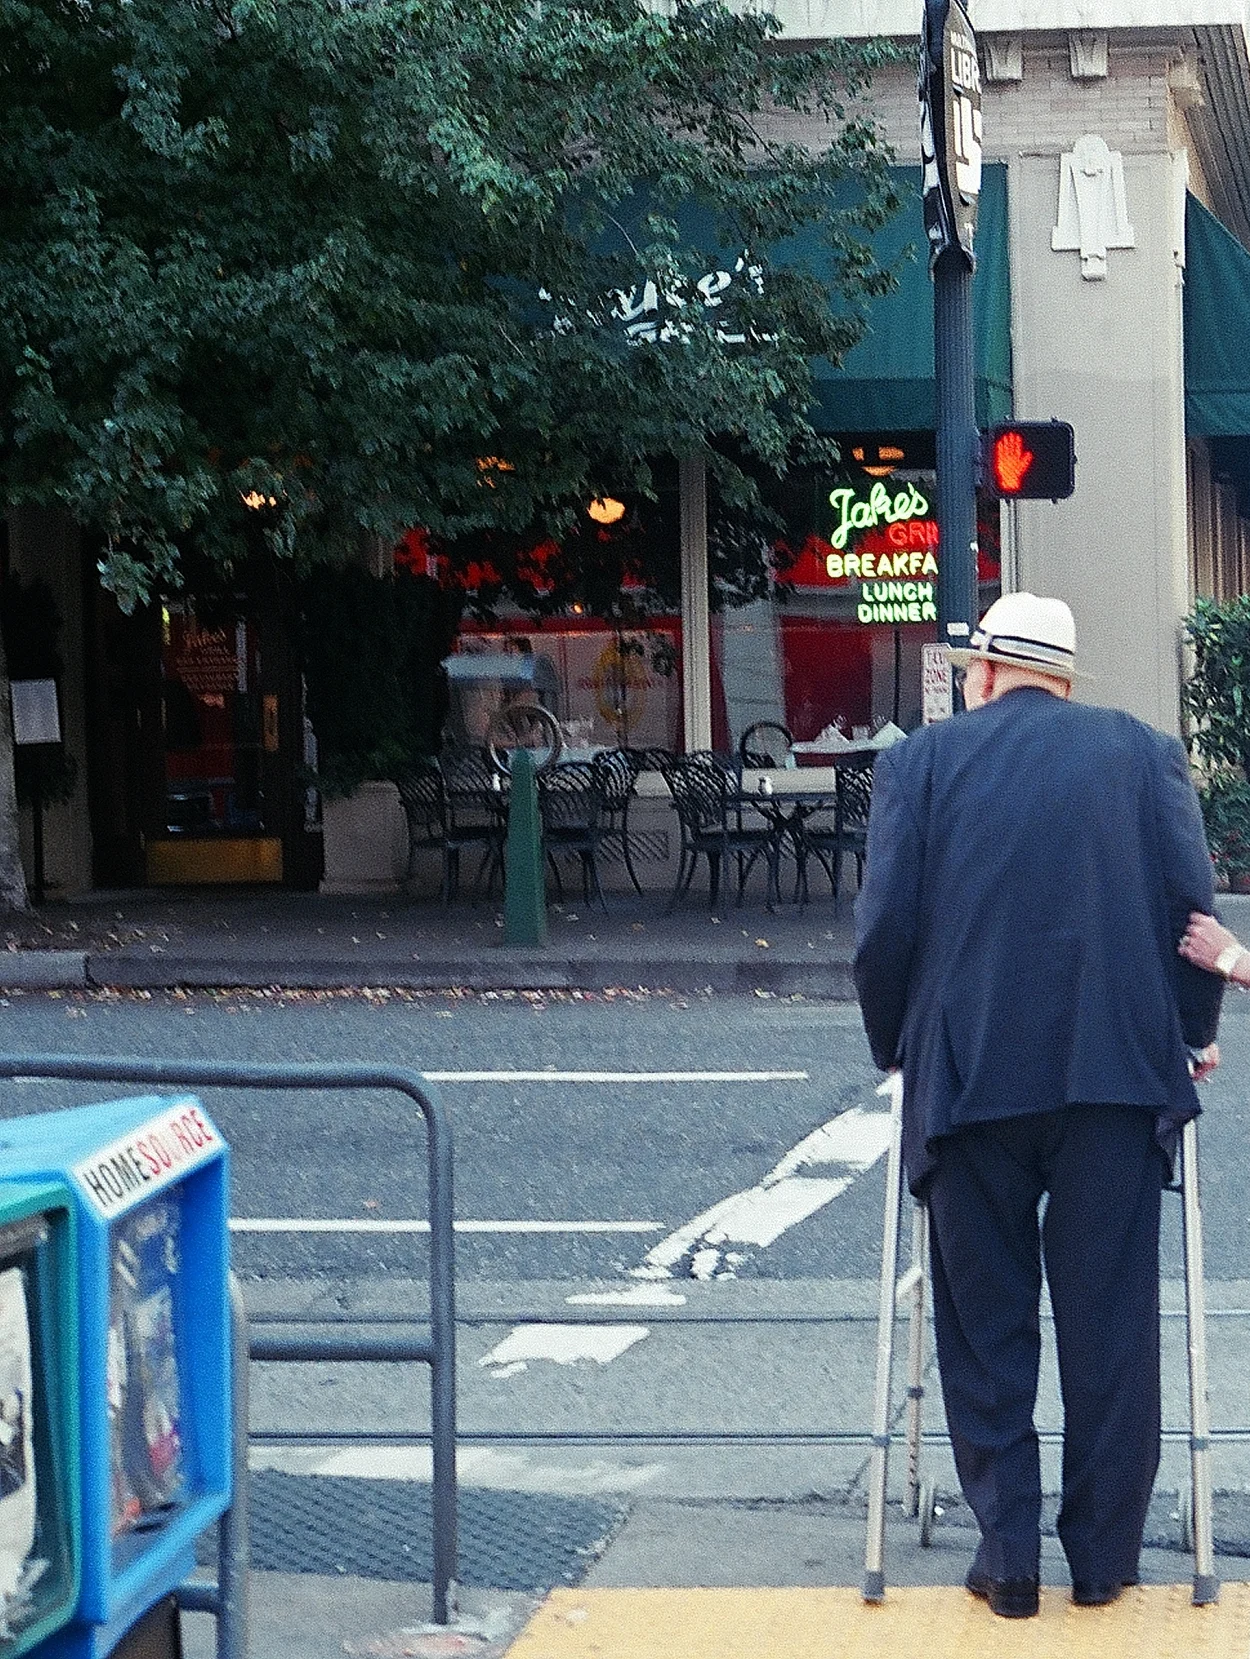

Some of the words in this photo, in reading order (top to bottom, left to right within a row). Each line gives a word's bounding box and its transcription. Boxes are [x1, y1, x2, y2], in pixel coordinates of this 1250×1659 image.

[829, 481, 929, 549] Jake's
[888, 520, 939, 546] GRI
[826, 552, 939, 578] BREAKFA
[862, 582, 933, 602] LUNCH
[857, 603, 937, 624] DINNER
[83, 1108, 214, 1207] HOMESORCE
